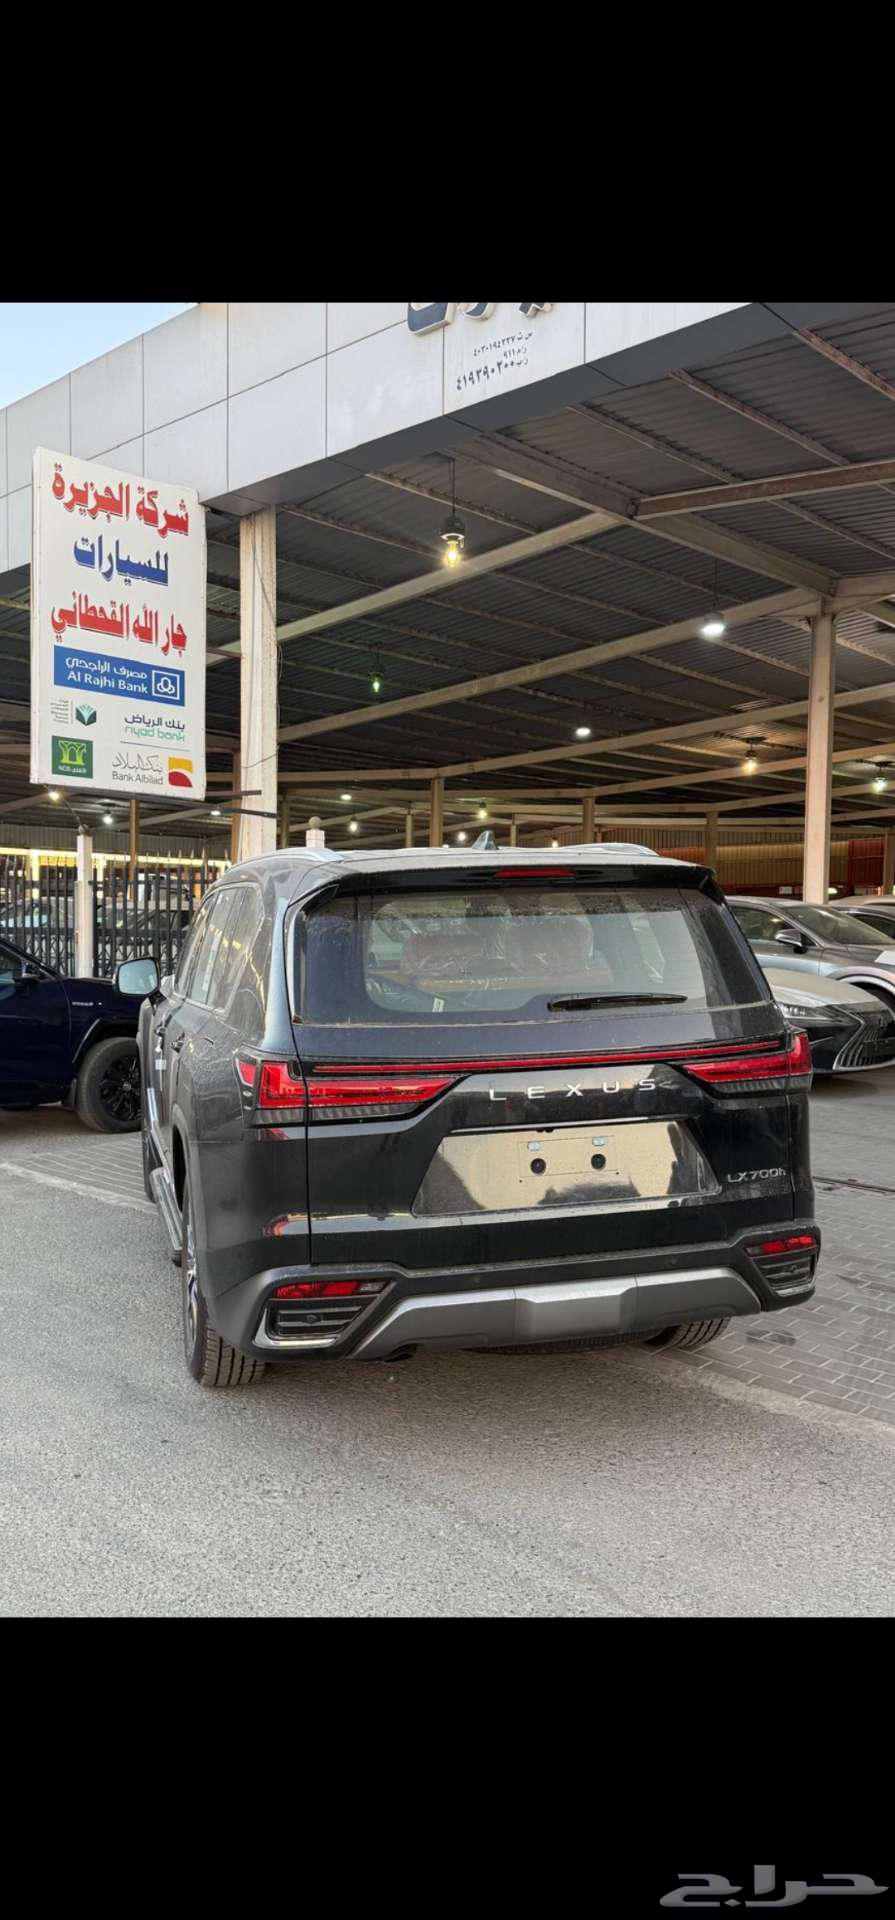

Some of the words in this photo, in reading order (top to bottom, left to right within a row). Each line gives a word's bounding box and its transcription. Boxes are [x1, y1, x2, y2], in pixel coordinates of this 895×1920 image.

[52, 463, 130, 523] الجزيرة
[136, 485, 189, 538] شركة
[73, 534, 168, 587] للسيارات
[51, 590, 130, 643] القحطاني
[132, 603, 158, 646] الله
[161, 613, 187, 658] جار
[65, 656, 110, 673] الراجحي
[113, 666, 147, 679] مصرف
[67, 671, 81, 681] Al
[84, 673, 114, 688] Rajhi
[118, 680, 148, 693] Bank
[124, 713, 162, 727] الرياض
[165, 719, 185, 732] بنك
[157, 727, 185, 741] bank
[112, 770, 133, 781] Bank
[134, 773, 163, 785] Albilad
[489, 1078, 656, 1101] LEXUS
[727, 1167, 787, 1183] LX700h
